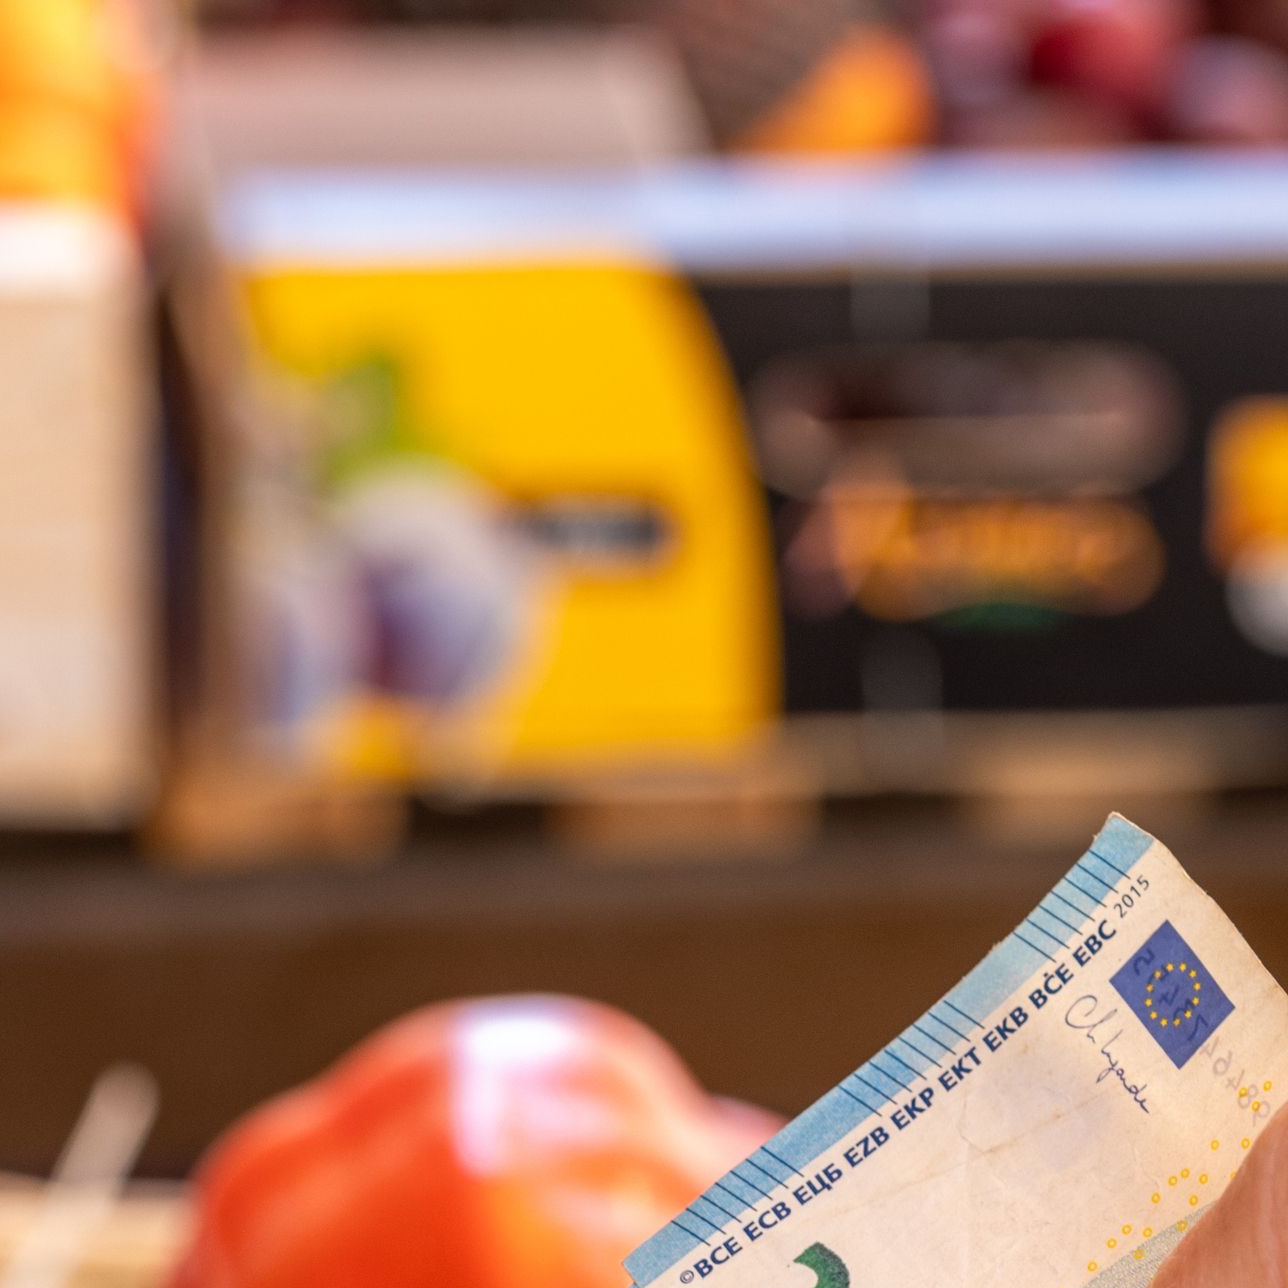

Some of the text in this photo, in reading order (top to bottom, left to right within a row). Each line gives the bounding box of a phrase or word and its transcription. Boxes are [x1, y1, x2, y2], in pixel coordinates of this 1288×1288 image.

[742, 1201, 792, 1242] ECB
[843, 1126, 890, 1168] EZB
[890, 1086, 935, 1131] EKP
[982, 1006, 1029, 1052] EKB
[1072, 920, 1117, 967] EBC
[1113, 875, 1151, 919] 2015
